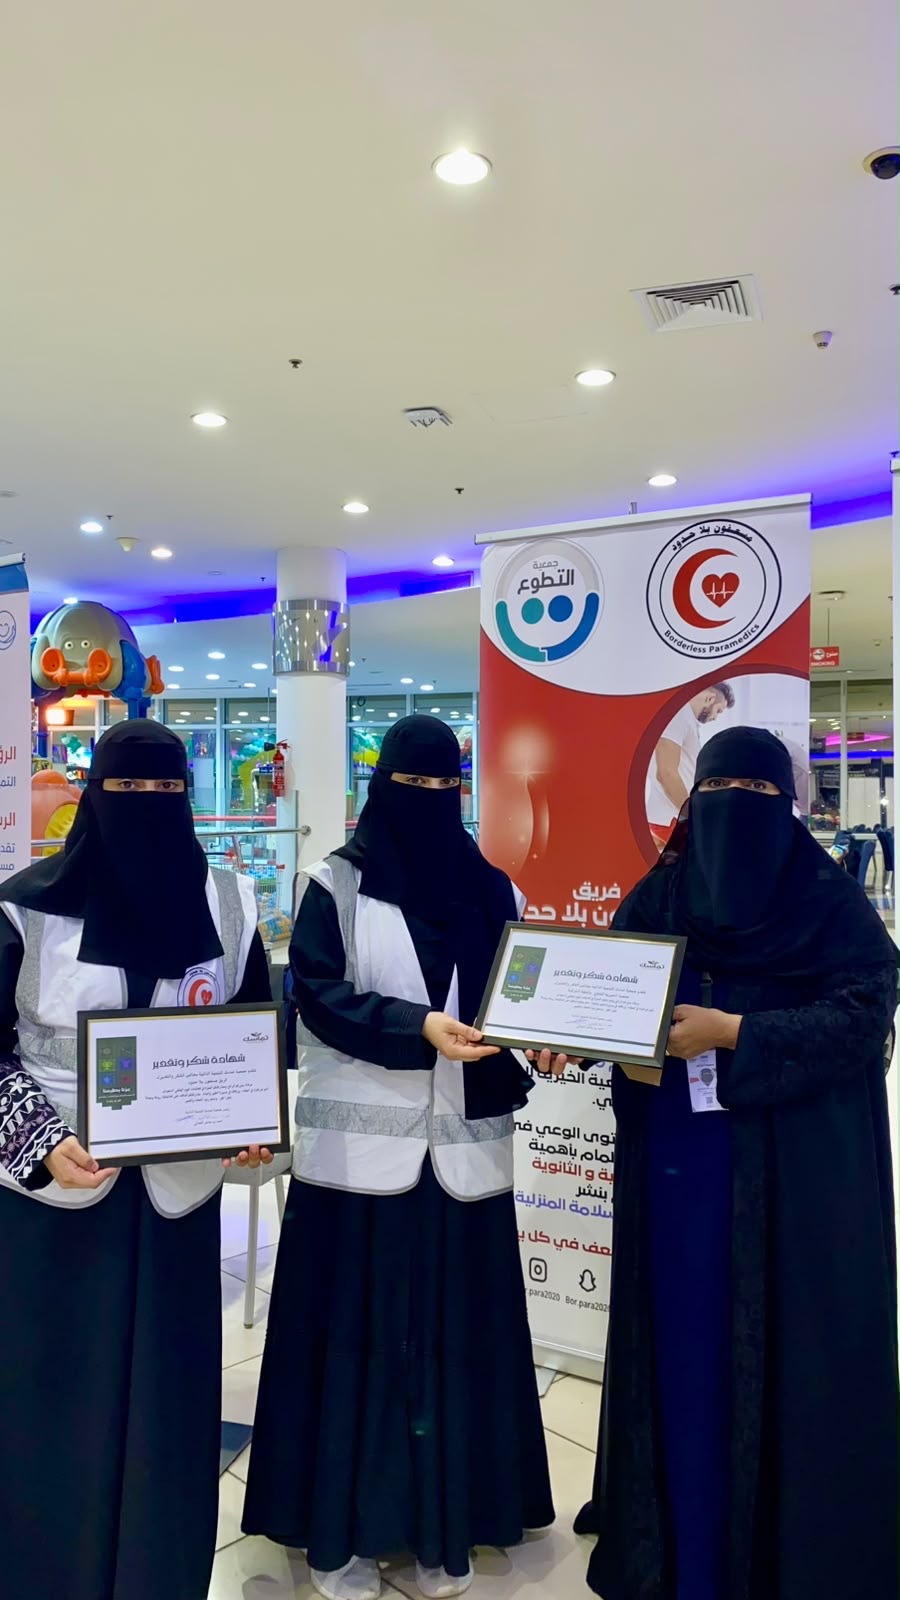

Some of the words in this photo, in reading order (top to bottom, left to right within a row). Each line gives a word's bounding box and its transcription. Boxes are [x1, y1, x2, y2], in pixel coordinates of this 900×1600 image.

[699, 525, 710, 535] بلا
[713, 524, 753, 542] مسعفون
[672, 531, 696, 551] حدود
[532, 560, 559, 571] جمعية
[517, 568, 575, 595] التطوع
[664, 629, 706, 653] Borderless
[709, 623, 760, 653] Paramedics
[572, 881, 621, 901] فريق
[524, 904, 556, 921] حد
[561, 902, 587, 927] بلا
[553, 969, 582, 980] وتقدير
[583, 970, 605, 981] شكر
[605, 974, 638, 984] شهادة
[152, 1058, 185, 1070] وتقدير
[186, 1055, 210, 1068] شكر
[211, 1053, 246, 1064] شهادة
[536, 1126, 580, 1139] الوعي
[528, 1138, 577, 1160] بأهمية
[532, 1157, 582, 1177] الثانوية
[585, 1169, 594, 1181] و
[515, 1190, 566, 1210] المنزلية
[575, 1184, 607, 1203] بنشر
[569, 1200, 613, 1219] سلامة
[528, 1230, 550, 1243] كل
[553, 1237, 579, 1251] في
[525, 1287, 560, 1302] .para2020
